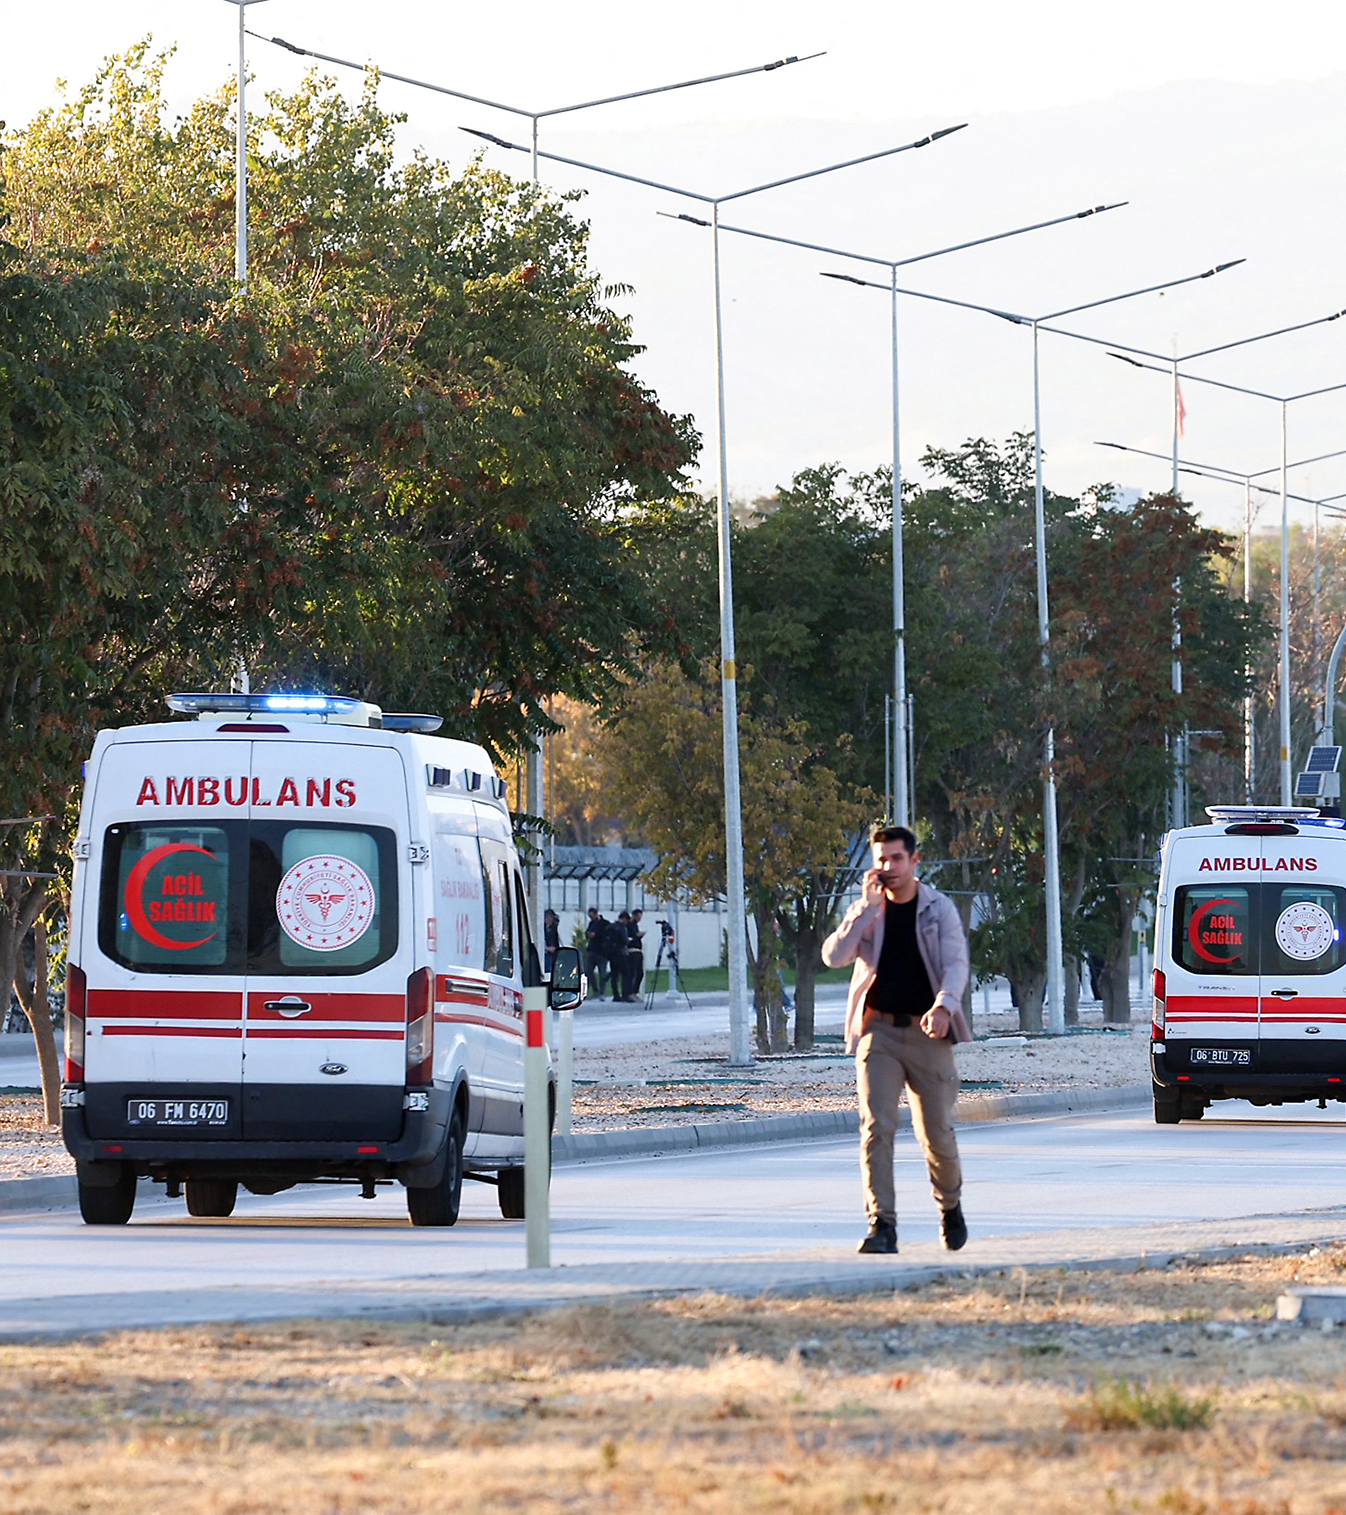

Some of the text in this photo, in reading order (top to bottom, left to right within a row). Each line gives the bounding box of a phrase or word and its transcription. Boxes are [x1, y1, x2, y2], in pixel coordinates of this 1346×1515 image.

[136, 776, 357, 808] AMBULANS
[1199, 858, 1318, 871] AMBULANS
[162, 872, 203, 896] ACİL
[150, 896, 217, 923] SAĞLIK
[1210, 915, 1235, 929] ACİL
[1203, 930, 1242, 945] SAĞLIK
[1196, 1050, 1248, 1061] 06 BTU 725
[138, 1103, 224, 1119] 06 FM 6470
